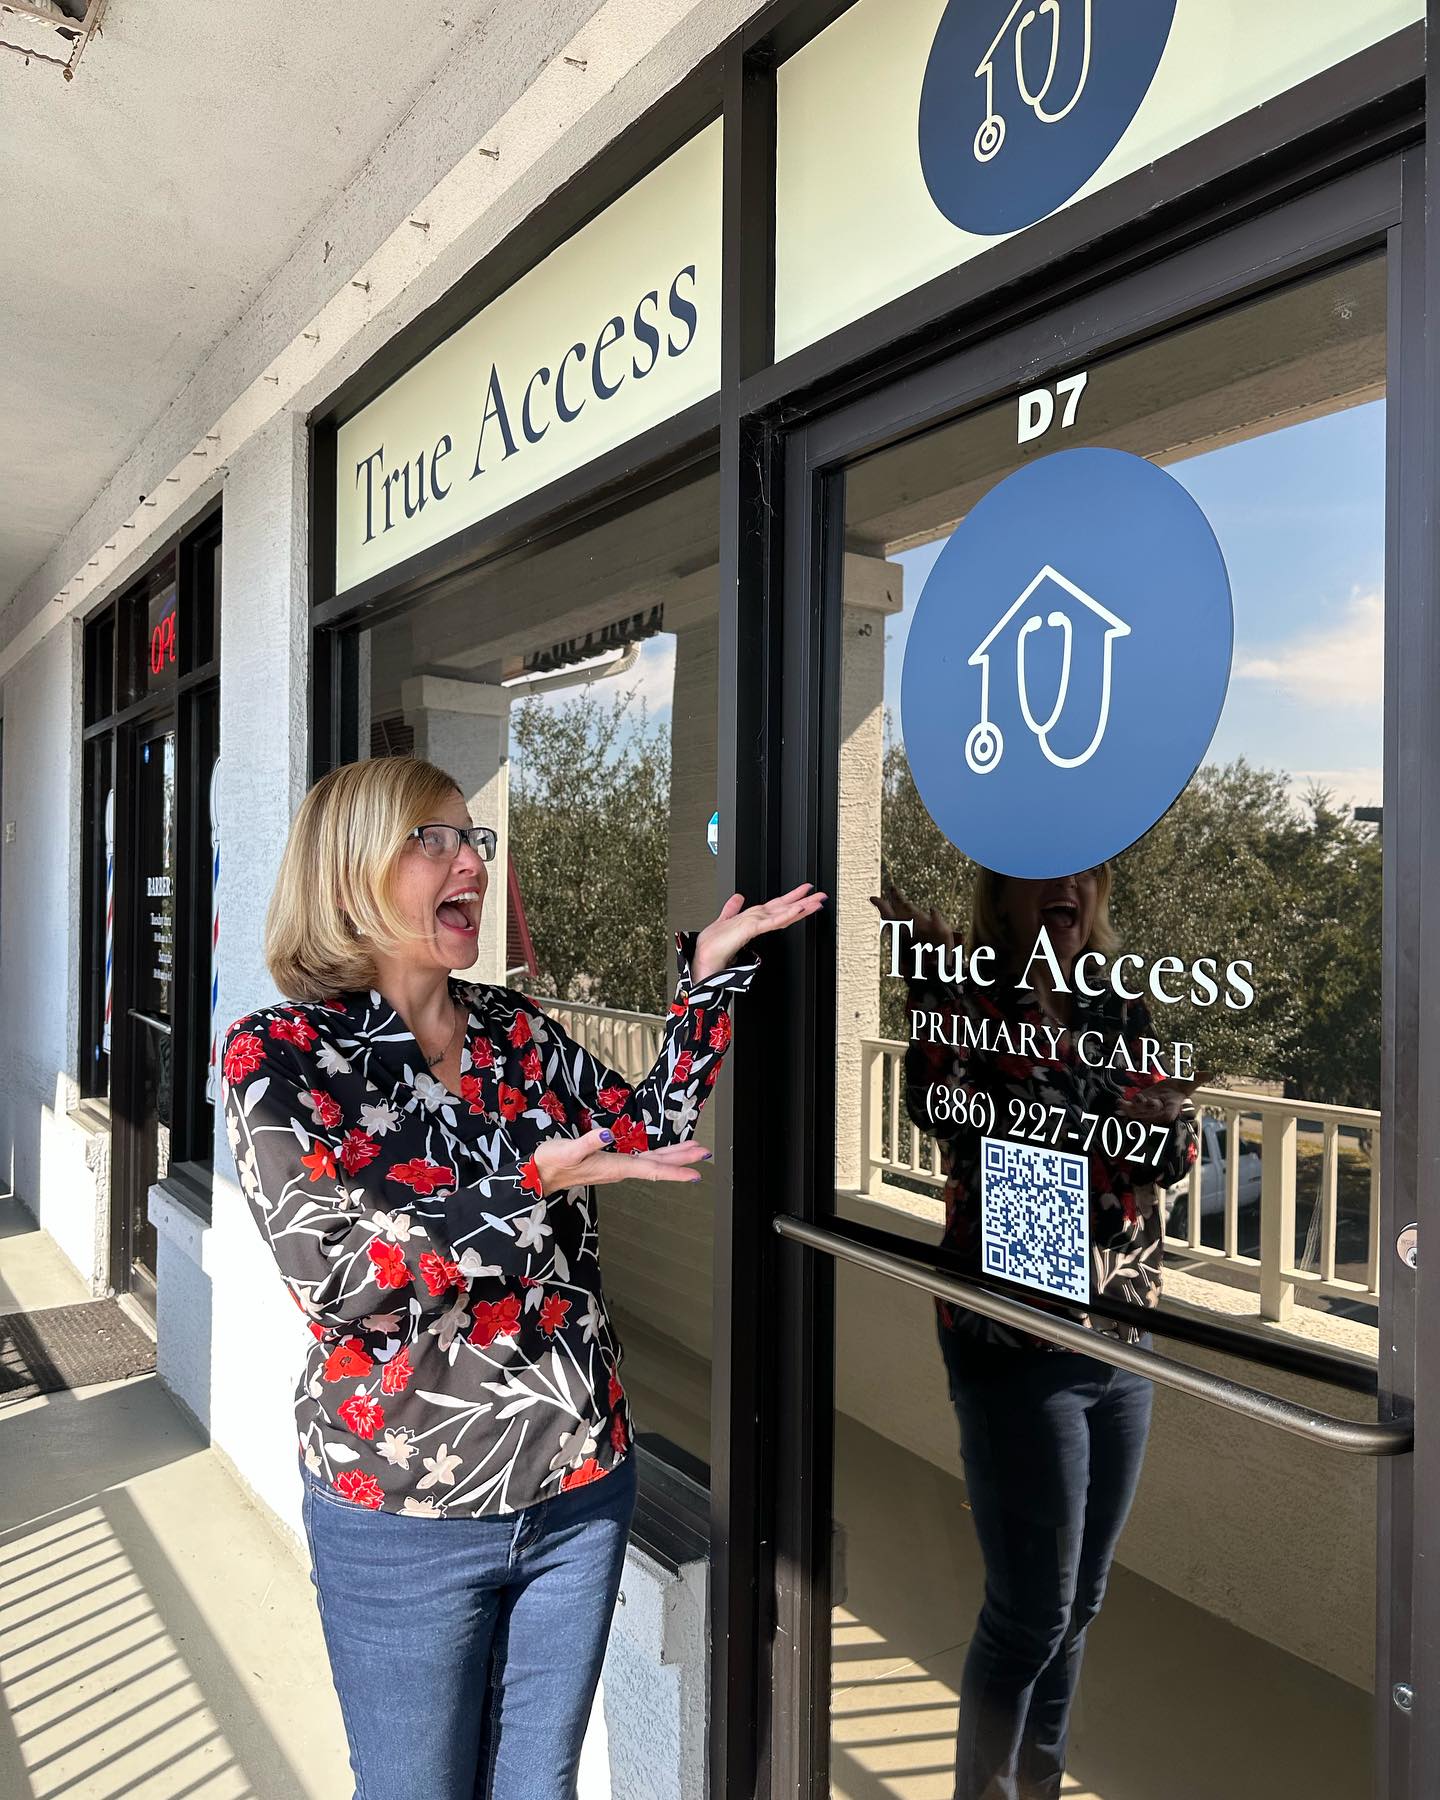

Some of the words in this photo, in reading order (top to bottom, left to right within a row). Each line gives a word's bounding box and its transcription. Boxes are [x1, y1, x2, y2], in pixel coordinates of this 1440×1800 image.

[355, 434, 453, 546] True
[469, 264, 697, 482] Access
[1017, 371, 1088, 445] D7
[151, 610, 176, 674] OPE
[879, 918, 996, 987] True
[1015, 925, 1254, 1010] Access
[910, 1009, 1068, 1062] PRIMARY
[1077, 1031, 1196, 1082] CARE
[926, 1082, 996, 1136] (386)
[1008, 1098, 1171, 1168] 227-7027
